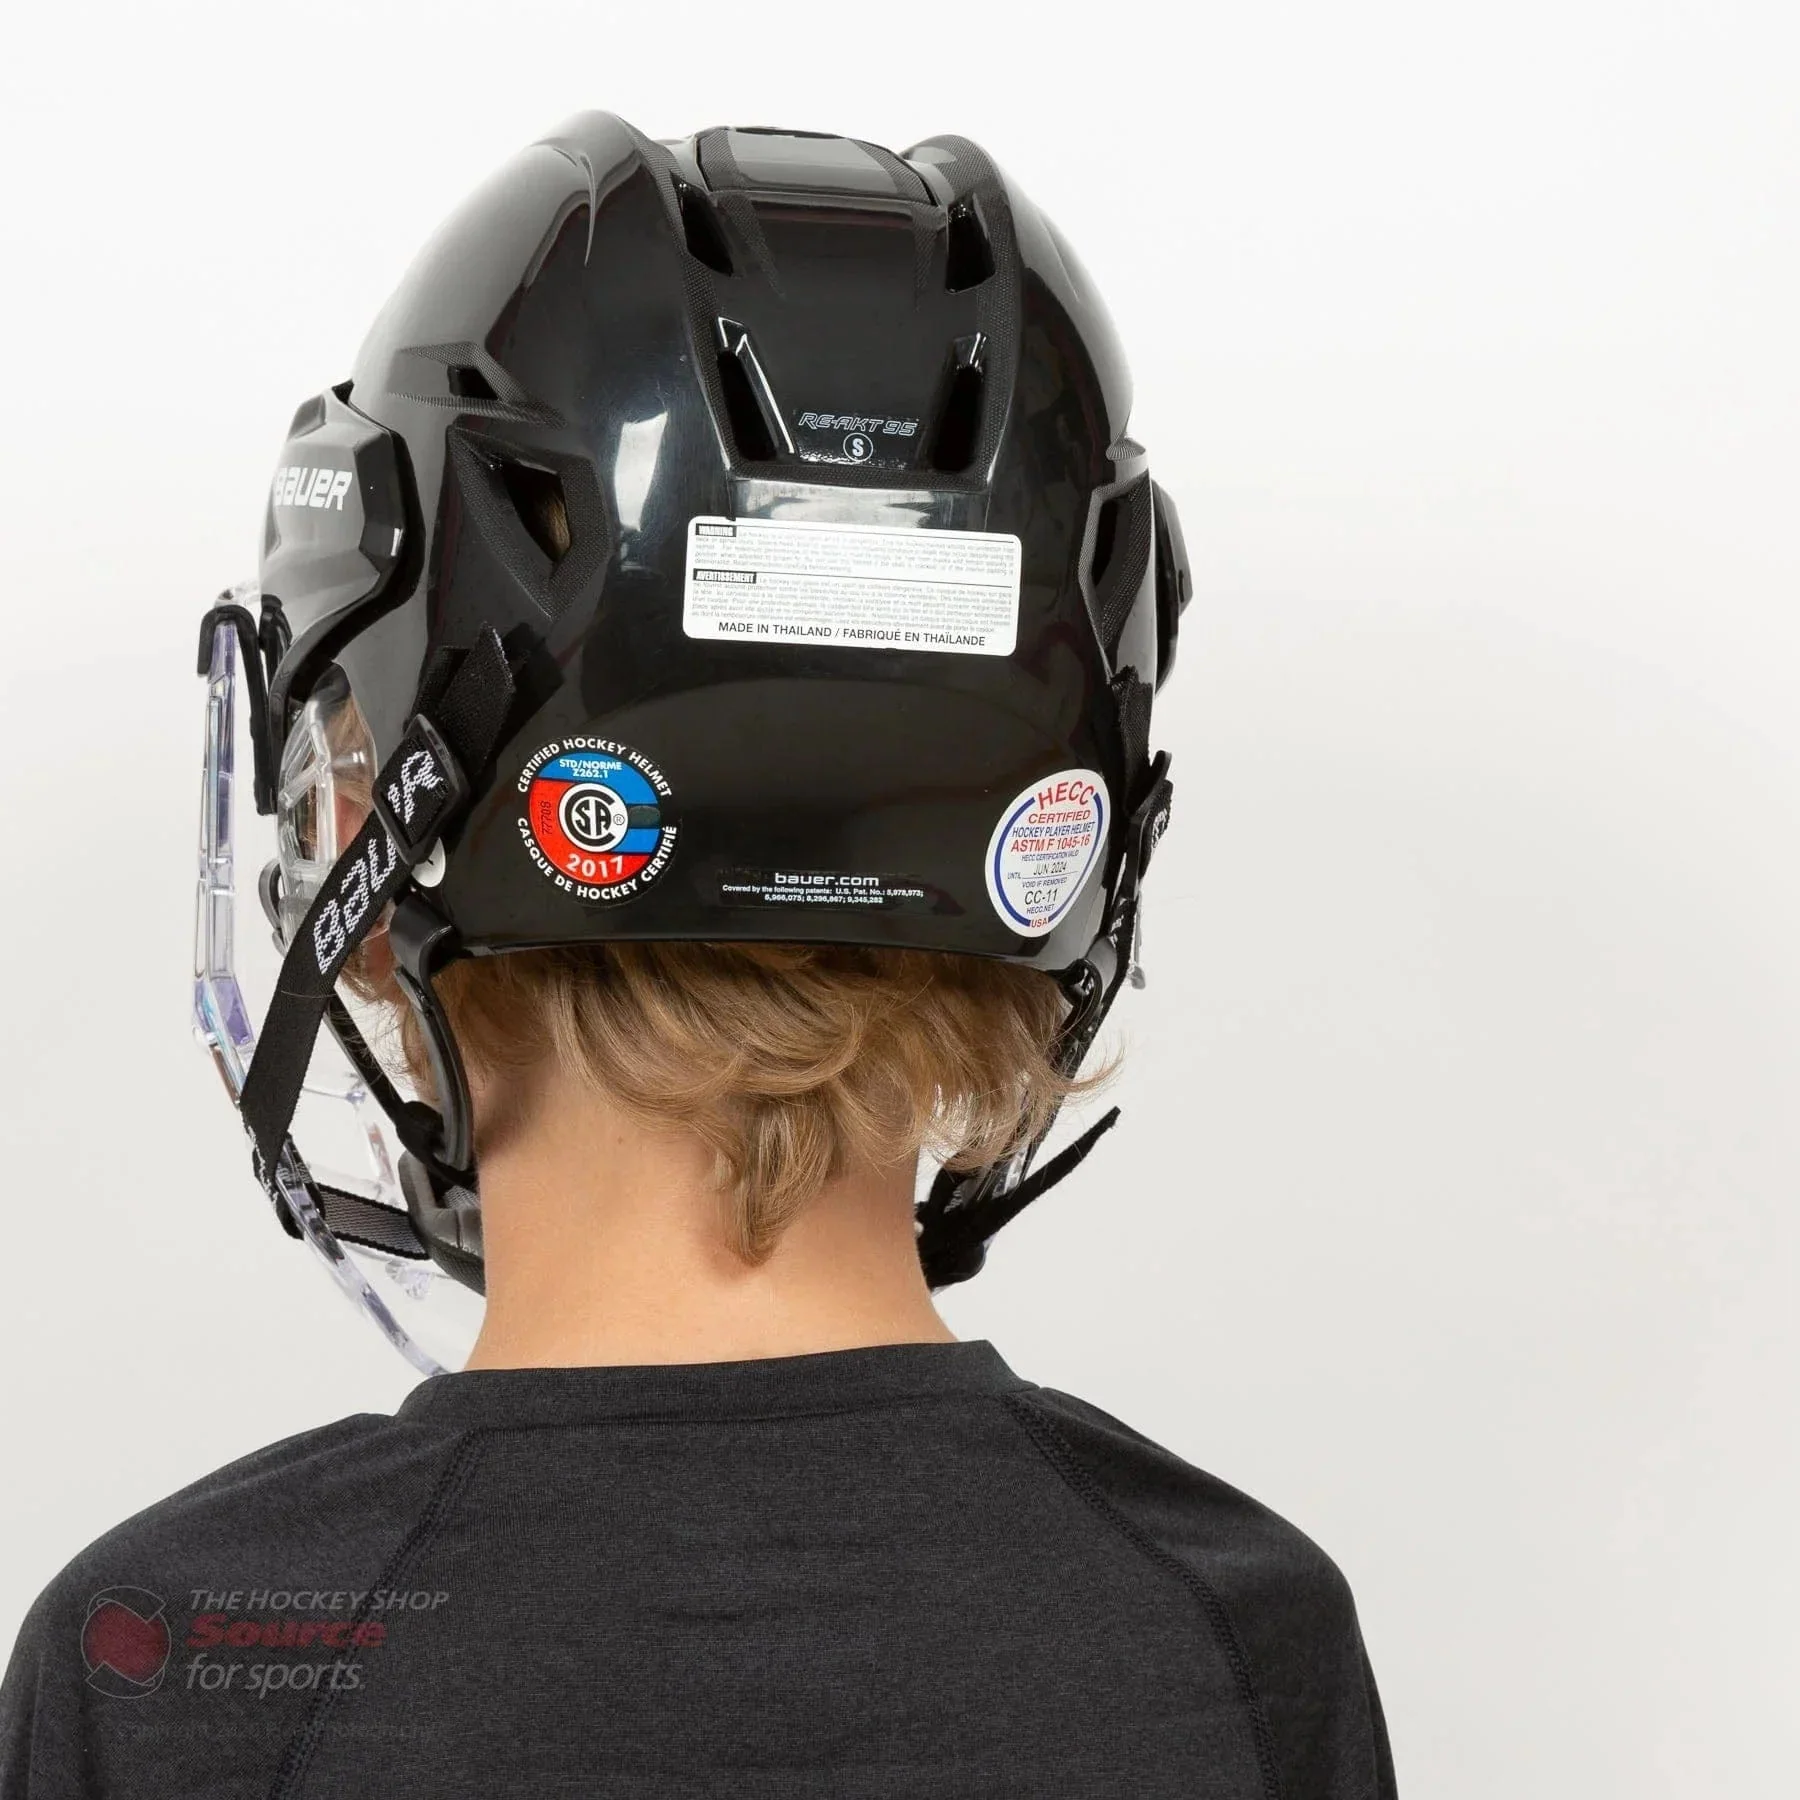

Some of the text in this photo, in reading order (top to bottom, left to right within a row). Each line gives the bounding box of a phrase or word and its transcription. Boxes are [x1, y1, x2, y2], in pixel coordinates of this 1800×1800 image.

[798, 412, 918, 437] RE-AKT 95
[851, 438, 864, 457] S
[718, 622, 753, 634] MADE
[757, 624, 769, 634] IN
[773, 624, 832, 638] THAILAND
[843, 628, 901, 642] FABRIQUÉ
[904, 631, 920, 642] EN
[923, 631, 985, 647] THAÏLANDE
[517, 737, 672, 797] CERTIFIED HOCKEY HELMET
[559, 759, 622, 770] STD/NORME
[572, 769, 609, 779] Z262.1
[1038, 780, 1095, 810] HECC
[1028, 809, 1091, 824] CERTIFIED
[1012, 821, 1096, 838] HOCKEY PLAYER HELMET
[1011, 834, 1091, 853] ASTM F 1045-16
[517, 817, 677, 900] CASQUE DE HOCKEY CERTIFIÉ
[566, 853, 624, 879] 2017
[1033, 864, 1050, 876] JUN
[774, 872, 879, 887] bauer.com
[722, 884, 751, 893] Covered
[751, 885, 761, 894] by
[762, 885, 773, 893] the
[773, 885, 804, 896] following
[835, 887, 851, 895] U.S.
[853, 888, 868, 896] Pat.
[1024, 888, 1058, 905] CC-11
[1031, 917, 1048, 928] USA
